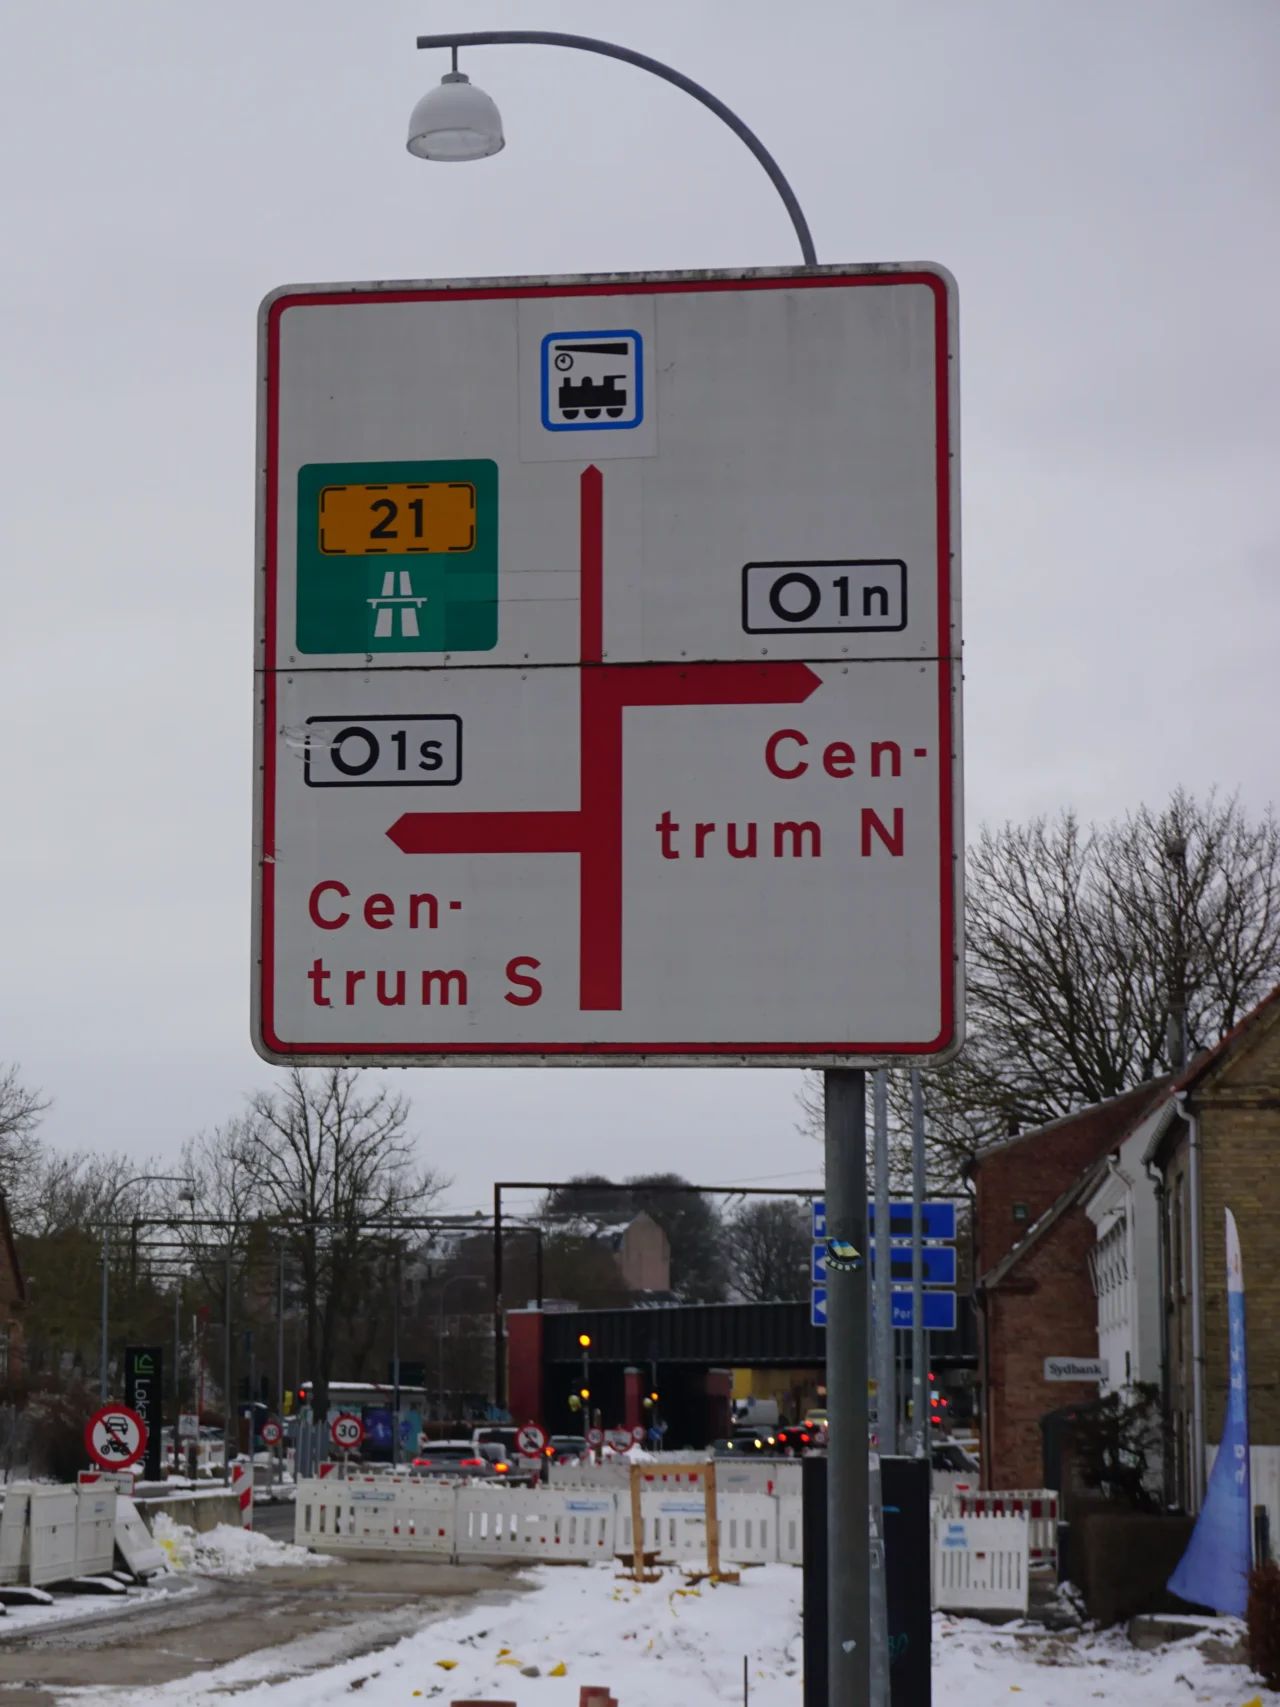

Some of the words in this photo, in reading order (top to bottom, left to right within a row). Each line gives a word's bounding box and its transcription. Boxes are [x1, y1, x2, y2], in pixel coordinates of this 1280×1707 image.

[370, 498, 424, 539] 21
[769, 572, 889, 623] O1n
[330, 726, 443, 777] O1s
[765, 728, 928, 780] Cen-
[655, 811, 822, 860] trum
[861, 807, 904, 857] N
[308, 880, 462, 931] Cen-
[307, 958, 468, 1007] trum
[504, 955, 543, 1007] S
[1049, 1363, 1102, 1377] Sydbank
[338, 1424, 358, 1438] 30
